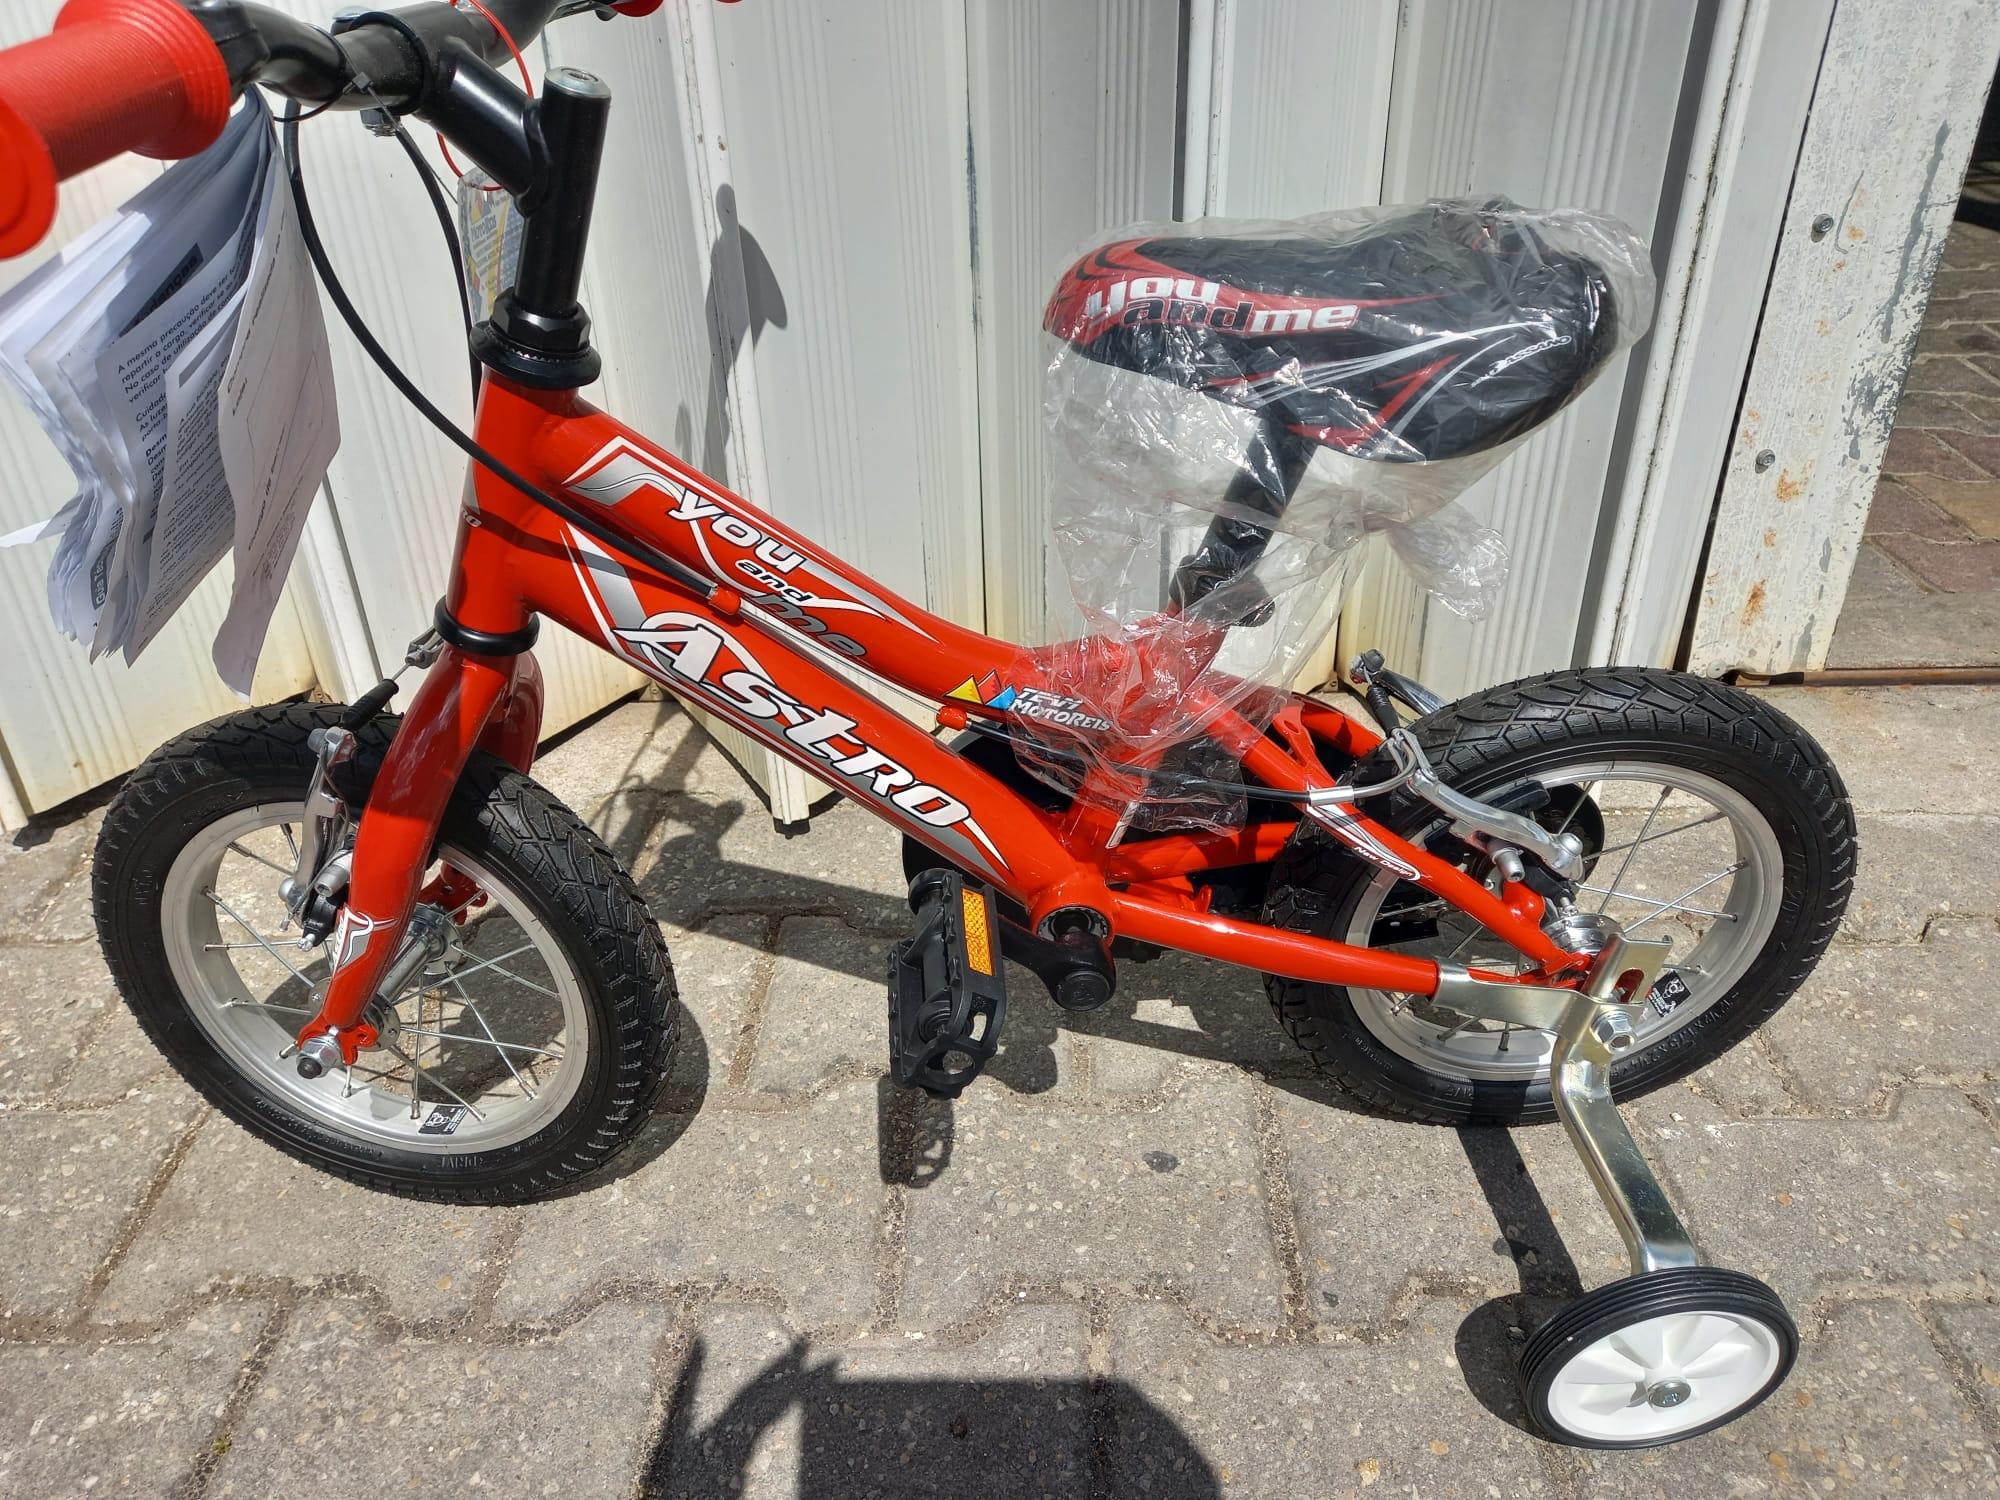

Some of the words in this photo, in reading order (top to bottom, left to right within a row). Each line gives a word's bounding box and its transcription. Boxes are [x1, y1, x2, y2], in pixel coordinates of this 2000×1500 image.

[1086, 275, 1221, 321] you
[1121, 297, 1254, 332] and
[1250, 303, 1362, 333] me
[126, 339, 159, 367] mesma
[159, 304, 200, 344] precaução
[121, 355, 153, 384] repartir
[124, 382, 139, 394] No
[140, 364, 160, 382] caso
[161, 354, 172, 365] de
[129, 374, 161, 404] verificar
[666, 487, 808, 575] you
[734, 557, 820, 605] and
[748, 593, 868, 658] me
[1008, 697, 1115, 732] MOTOREIS
[1353, 845, 1379, 861] New
[1379, 859, 1414, 880] Design
